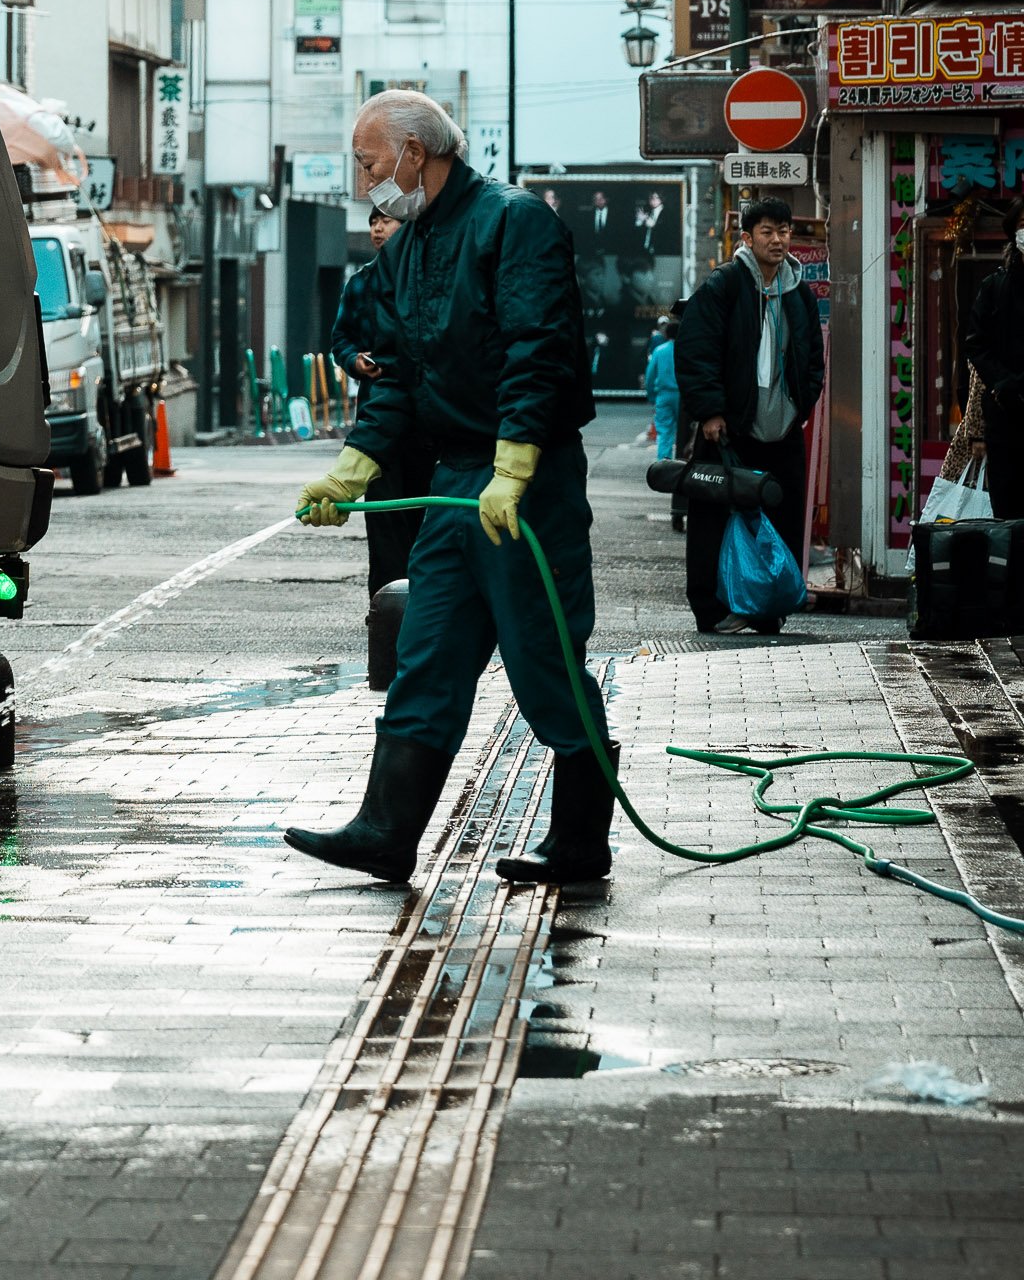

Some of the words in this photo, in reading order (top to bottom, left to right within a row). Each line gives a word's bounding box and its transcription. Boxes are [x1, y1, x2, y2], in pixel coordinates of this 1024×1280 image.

[731, 161, 802, 179] 自転車を除く
[691, 472, 724, 485] NANLITE
